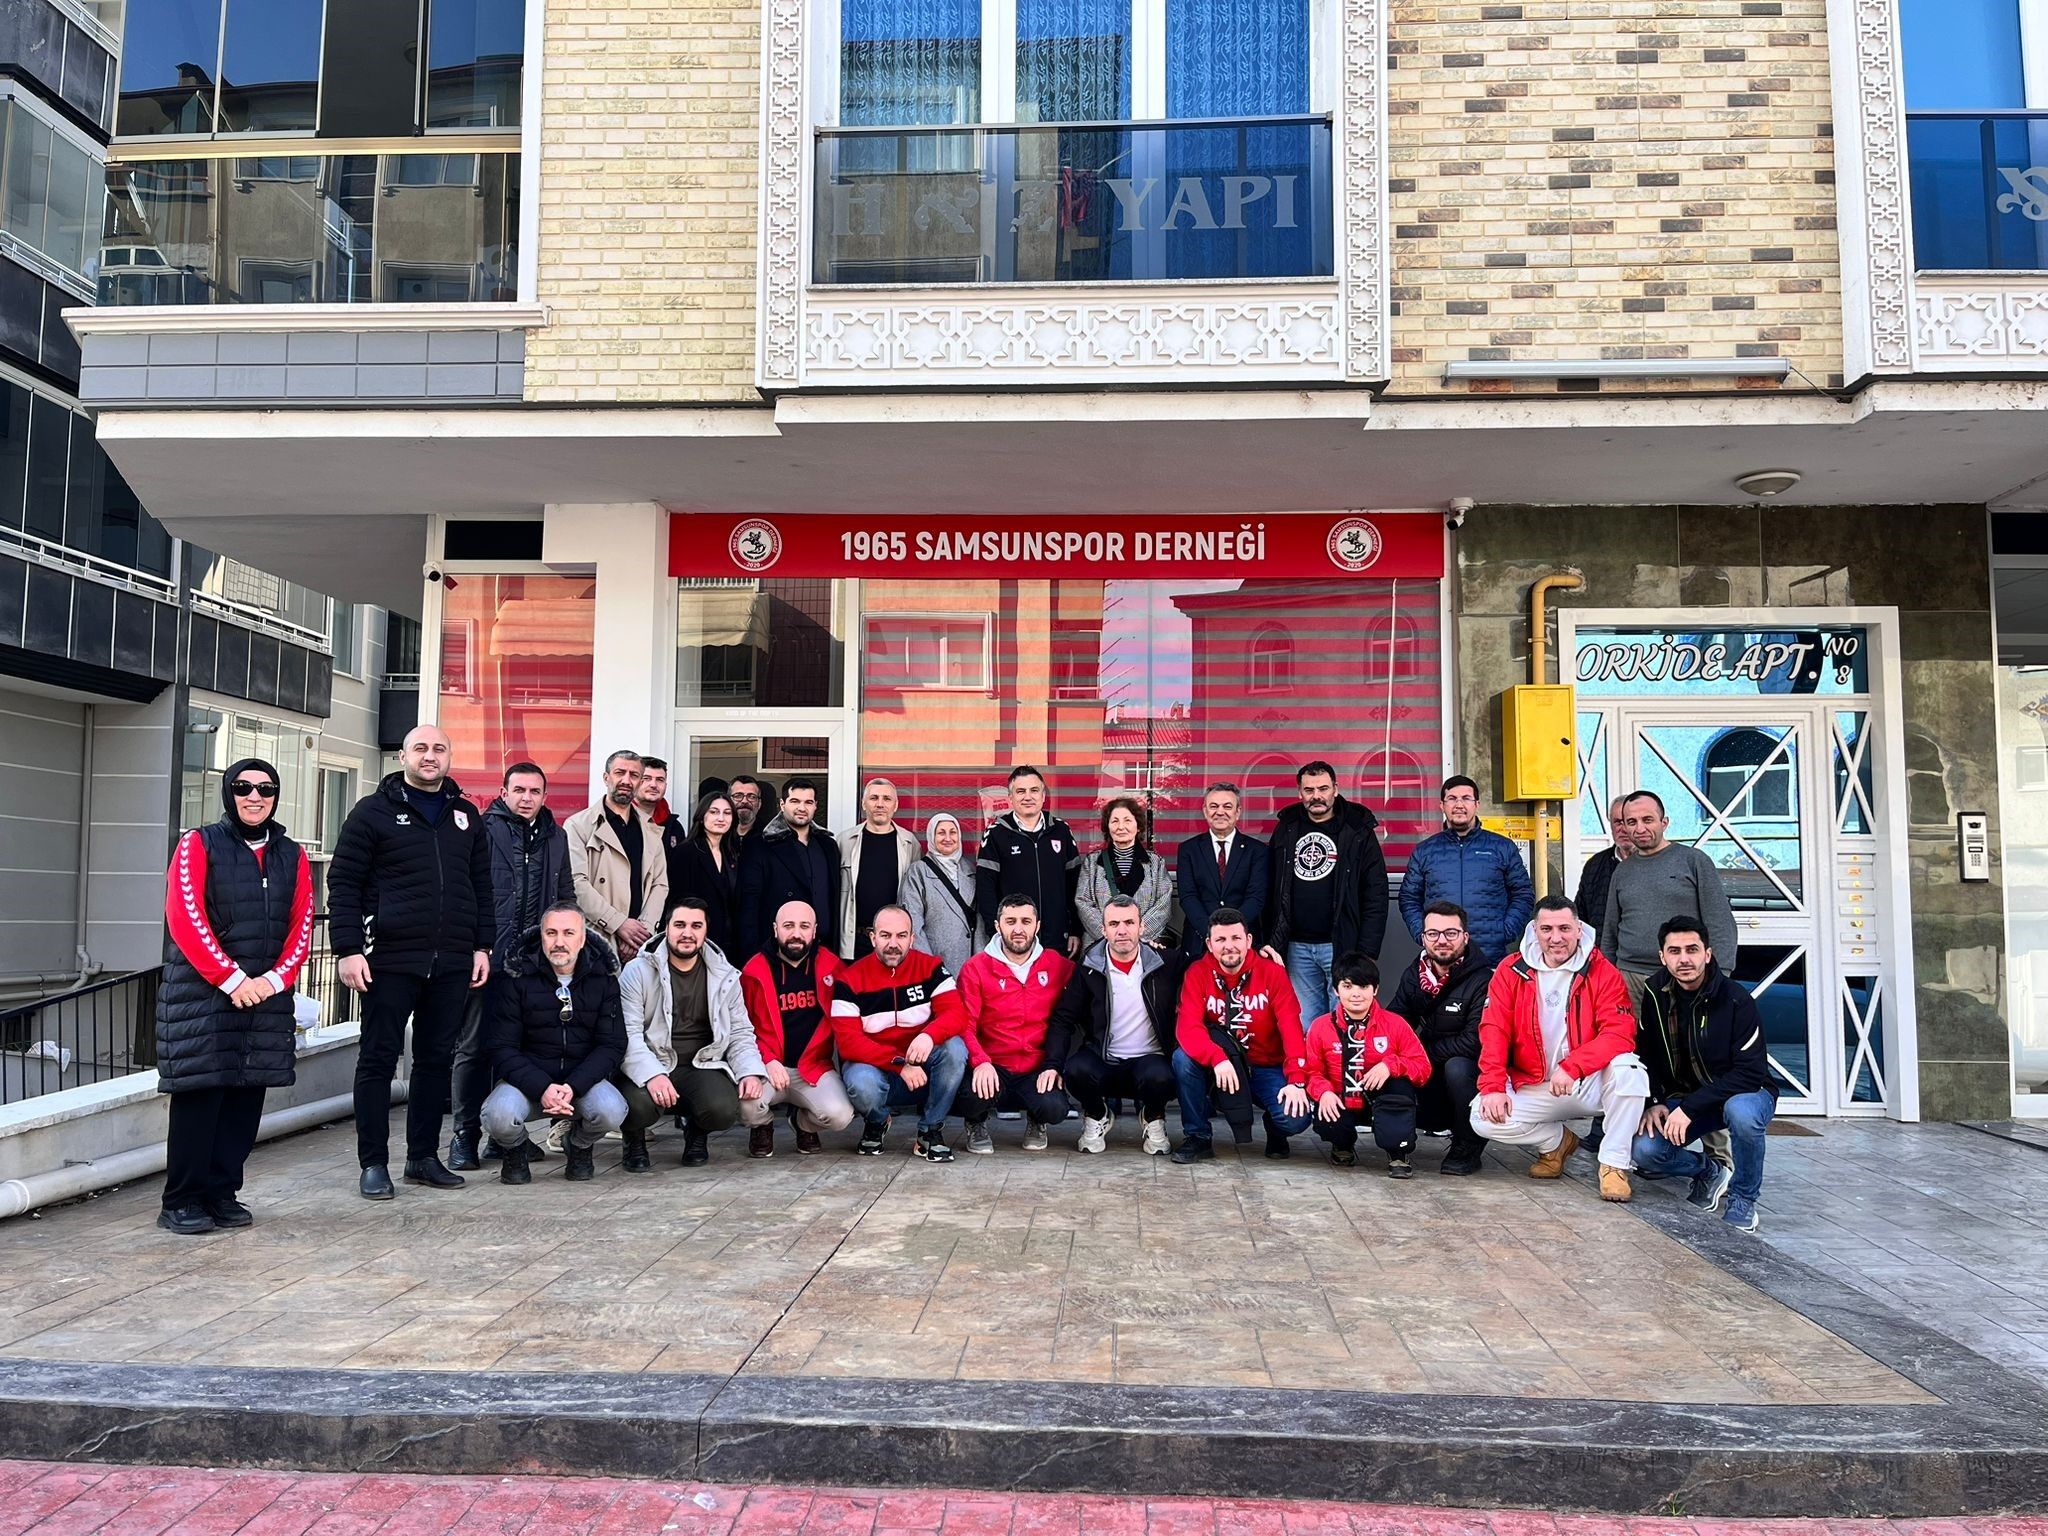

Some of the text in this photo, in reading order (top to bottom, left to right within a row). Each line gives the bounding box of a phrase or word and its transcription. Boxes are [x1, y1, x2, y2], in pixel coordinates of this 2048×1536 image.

[1104, 175, 1299, 231] YAPI
[841, 522, 1265, 562] 1965 SAMSUNSPOR DERNEĞİ
[1576, 634, 1818, 681] ORKİDE APT.
[1825, 637, 1859, 657] NO
[1836, 665, 1850, 685] 8
[779, 990, 817, 1011] 1965
[906, 985, 925, 1002] 55
